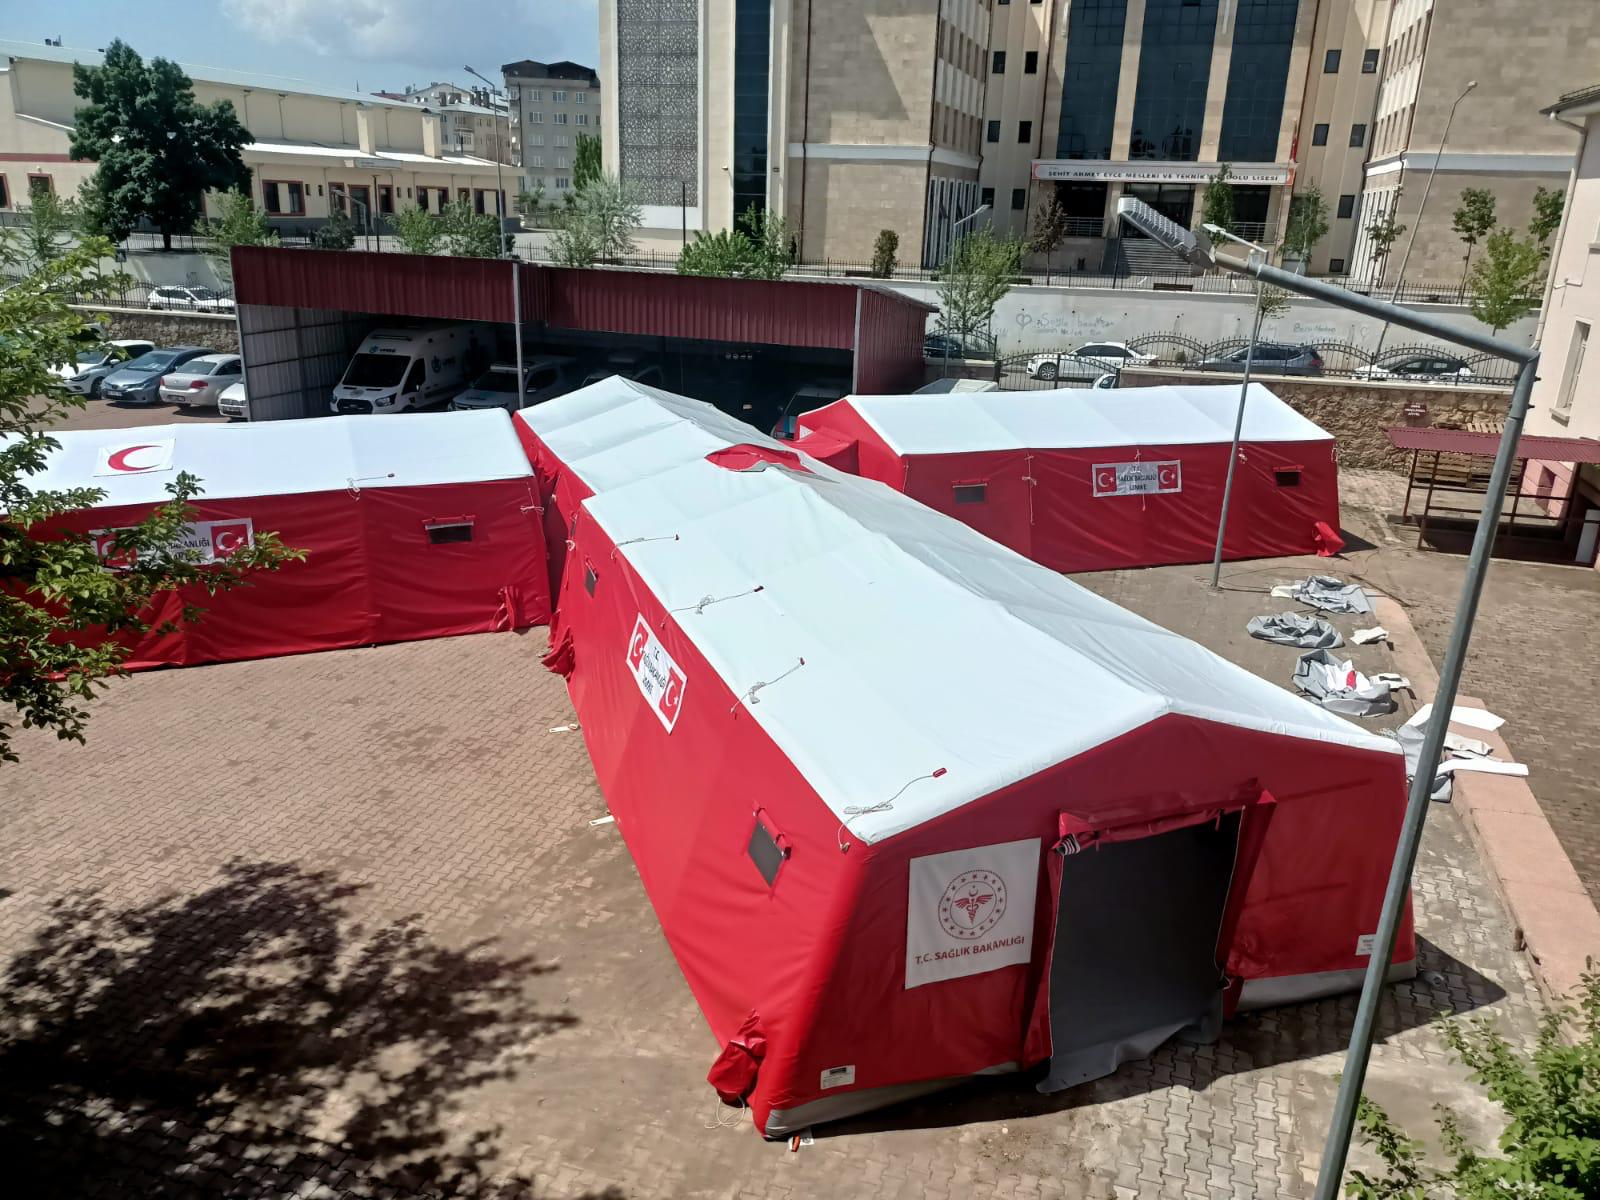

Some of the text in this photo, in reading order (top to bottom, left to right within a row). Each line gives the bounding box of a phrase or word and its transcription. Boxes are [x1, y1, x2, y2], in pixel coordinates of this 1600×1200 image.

[915, 935, 1025, 965] T.C. SAĞLIK BAKANLIĞI
